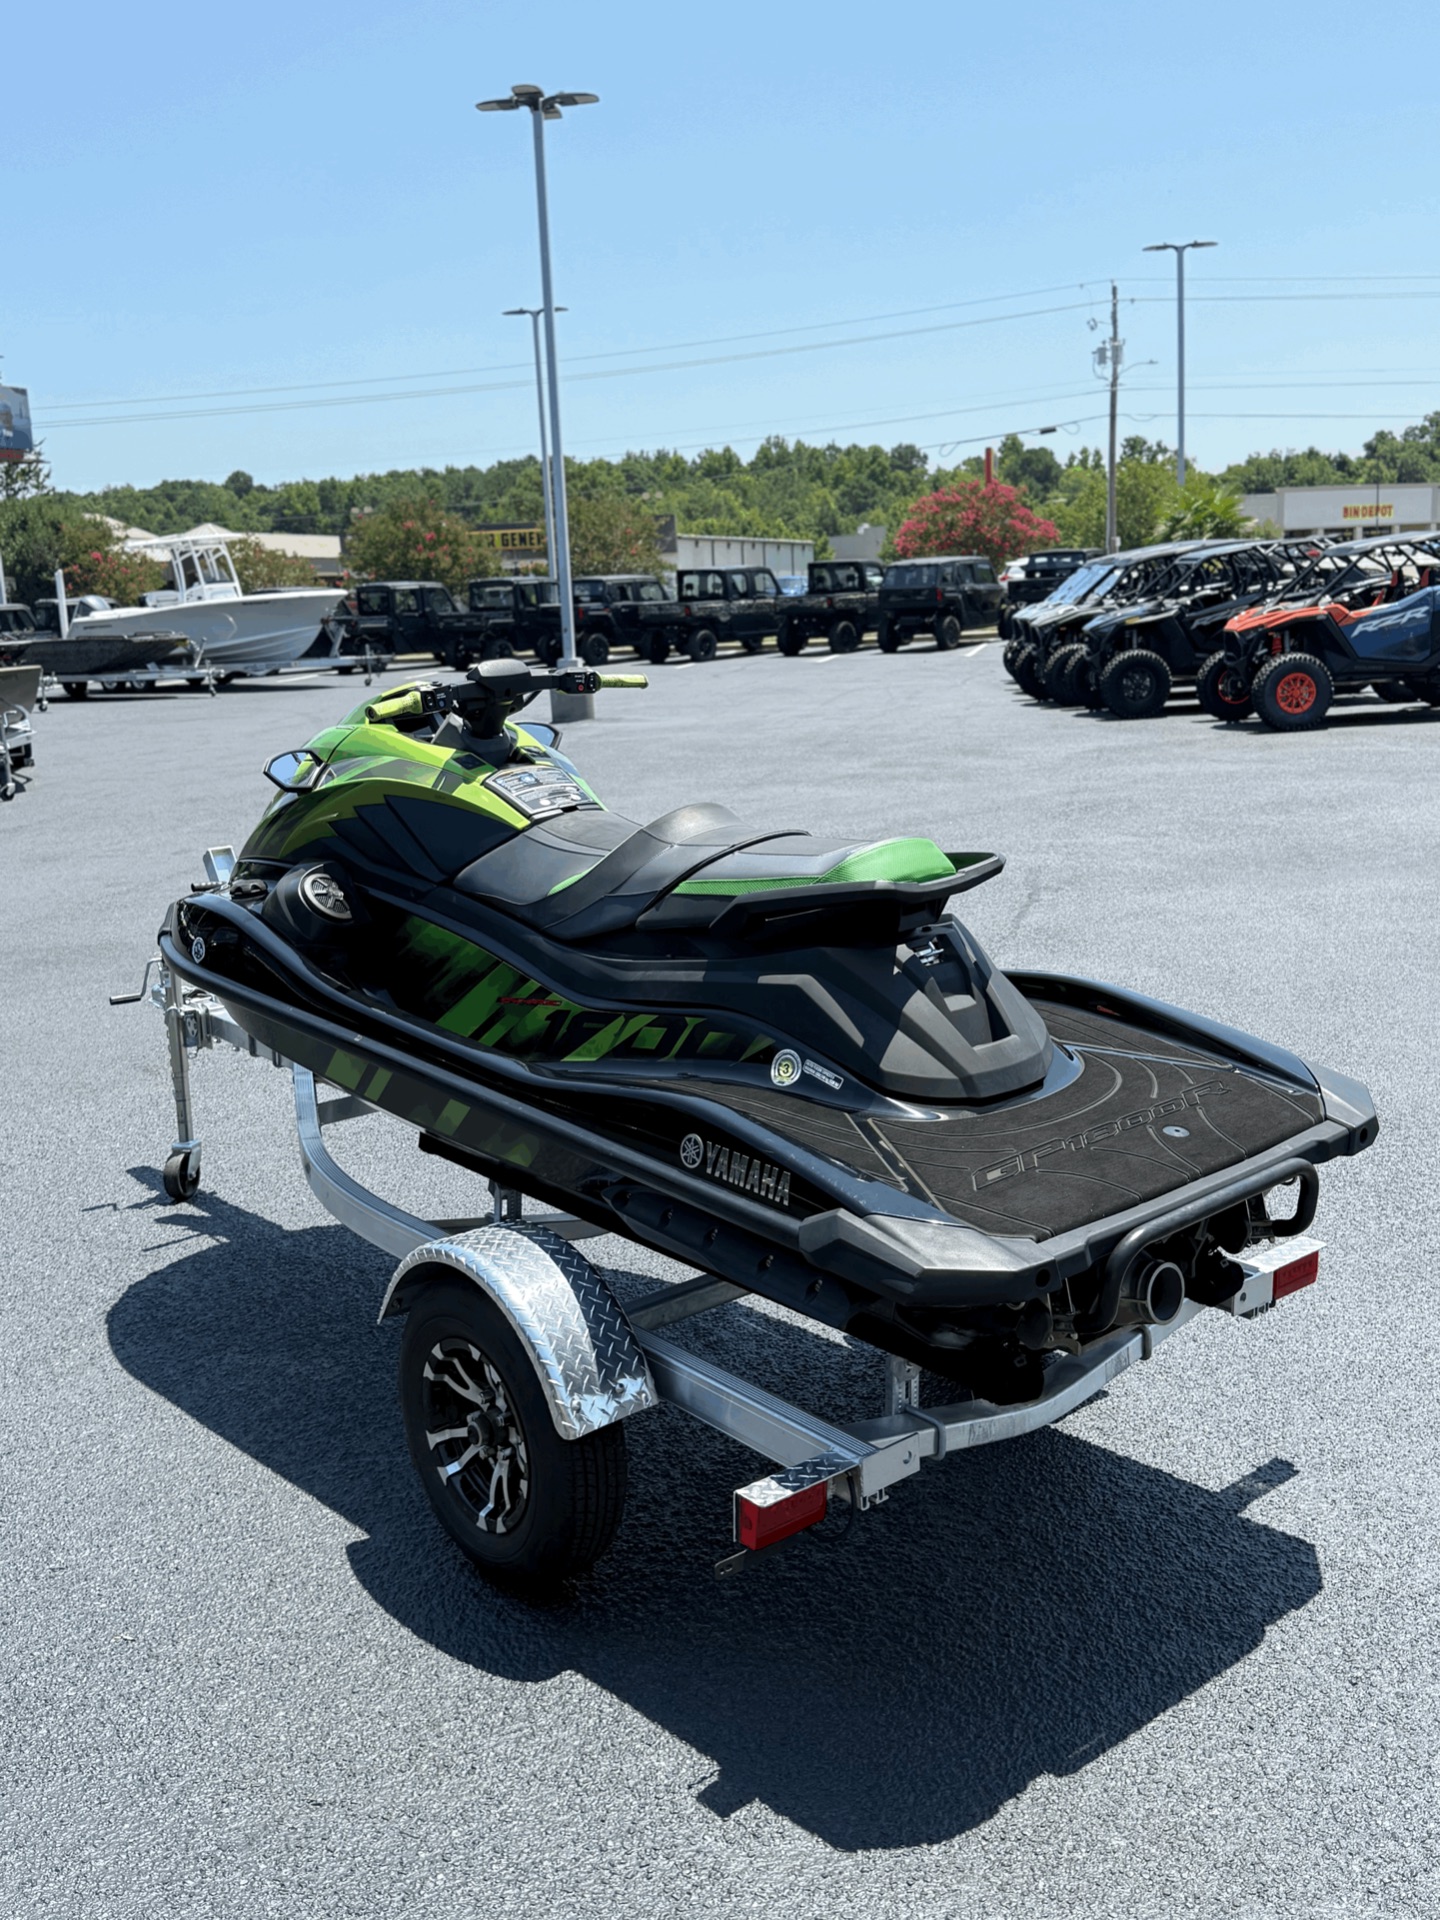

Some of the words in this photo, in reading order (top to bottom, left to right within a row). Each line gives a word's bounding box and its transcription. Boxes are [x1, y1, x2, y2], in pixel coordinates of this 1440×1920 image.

[1343, 505, 1360, 518] BIN
[1361, 504, 1393, 518] DEPOT
[1351, 606, 1430, 638] RZR
[782, 1063, 790, 1074] 3
[972, 1079, 1231, 1191] GP1800R
[706, 1141, 791, 1206] YAMAHA
